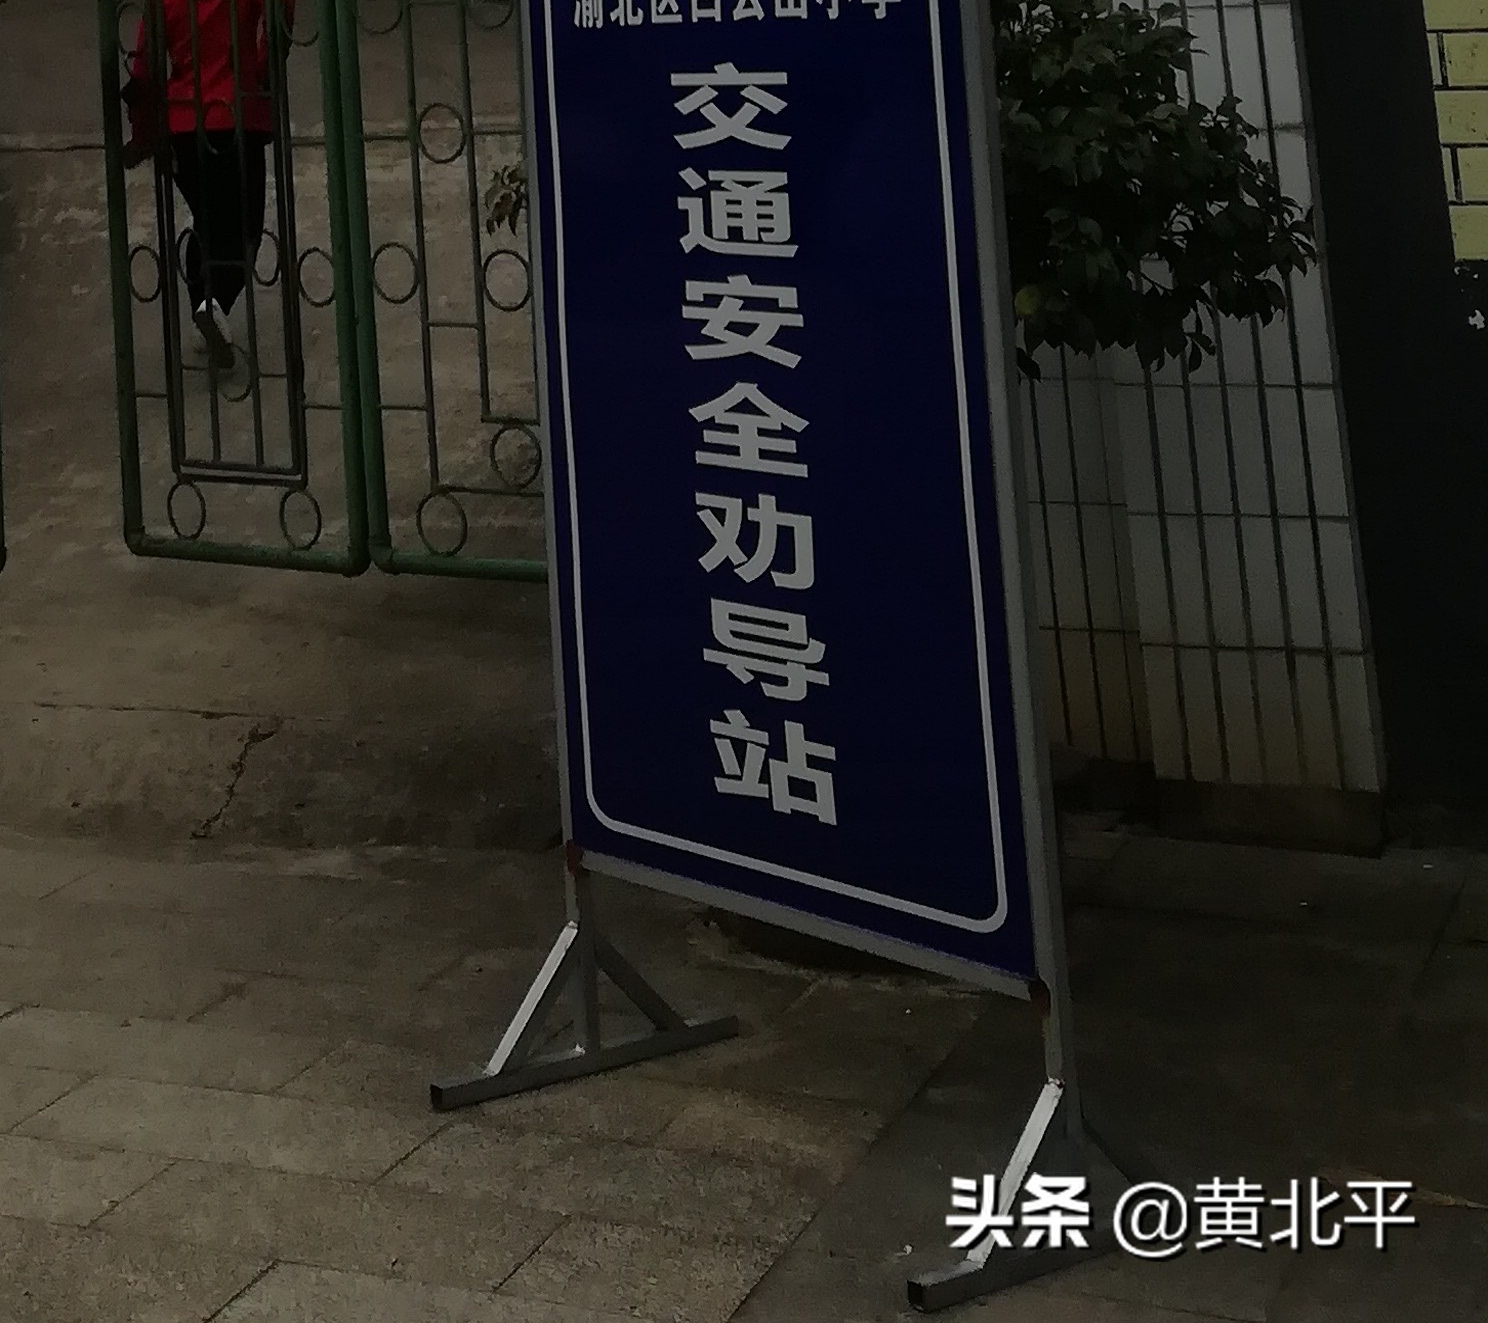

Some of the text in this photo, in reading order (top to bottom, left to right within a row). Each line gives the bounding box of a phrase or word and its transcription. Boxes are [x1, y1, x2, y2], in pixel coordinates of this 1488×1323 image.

[670, 62, 839, 826] 交通安全劝导站
